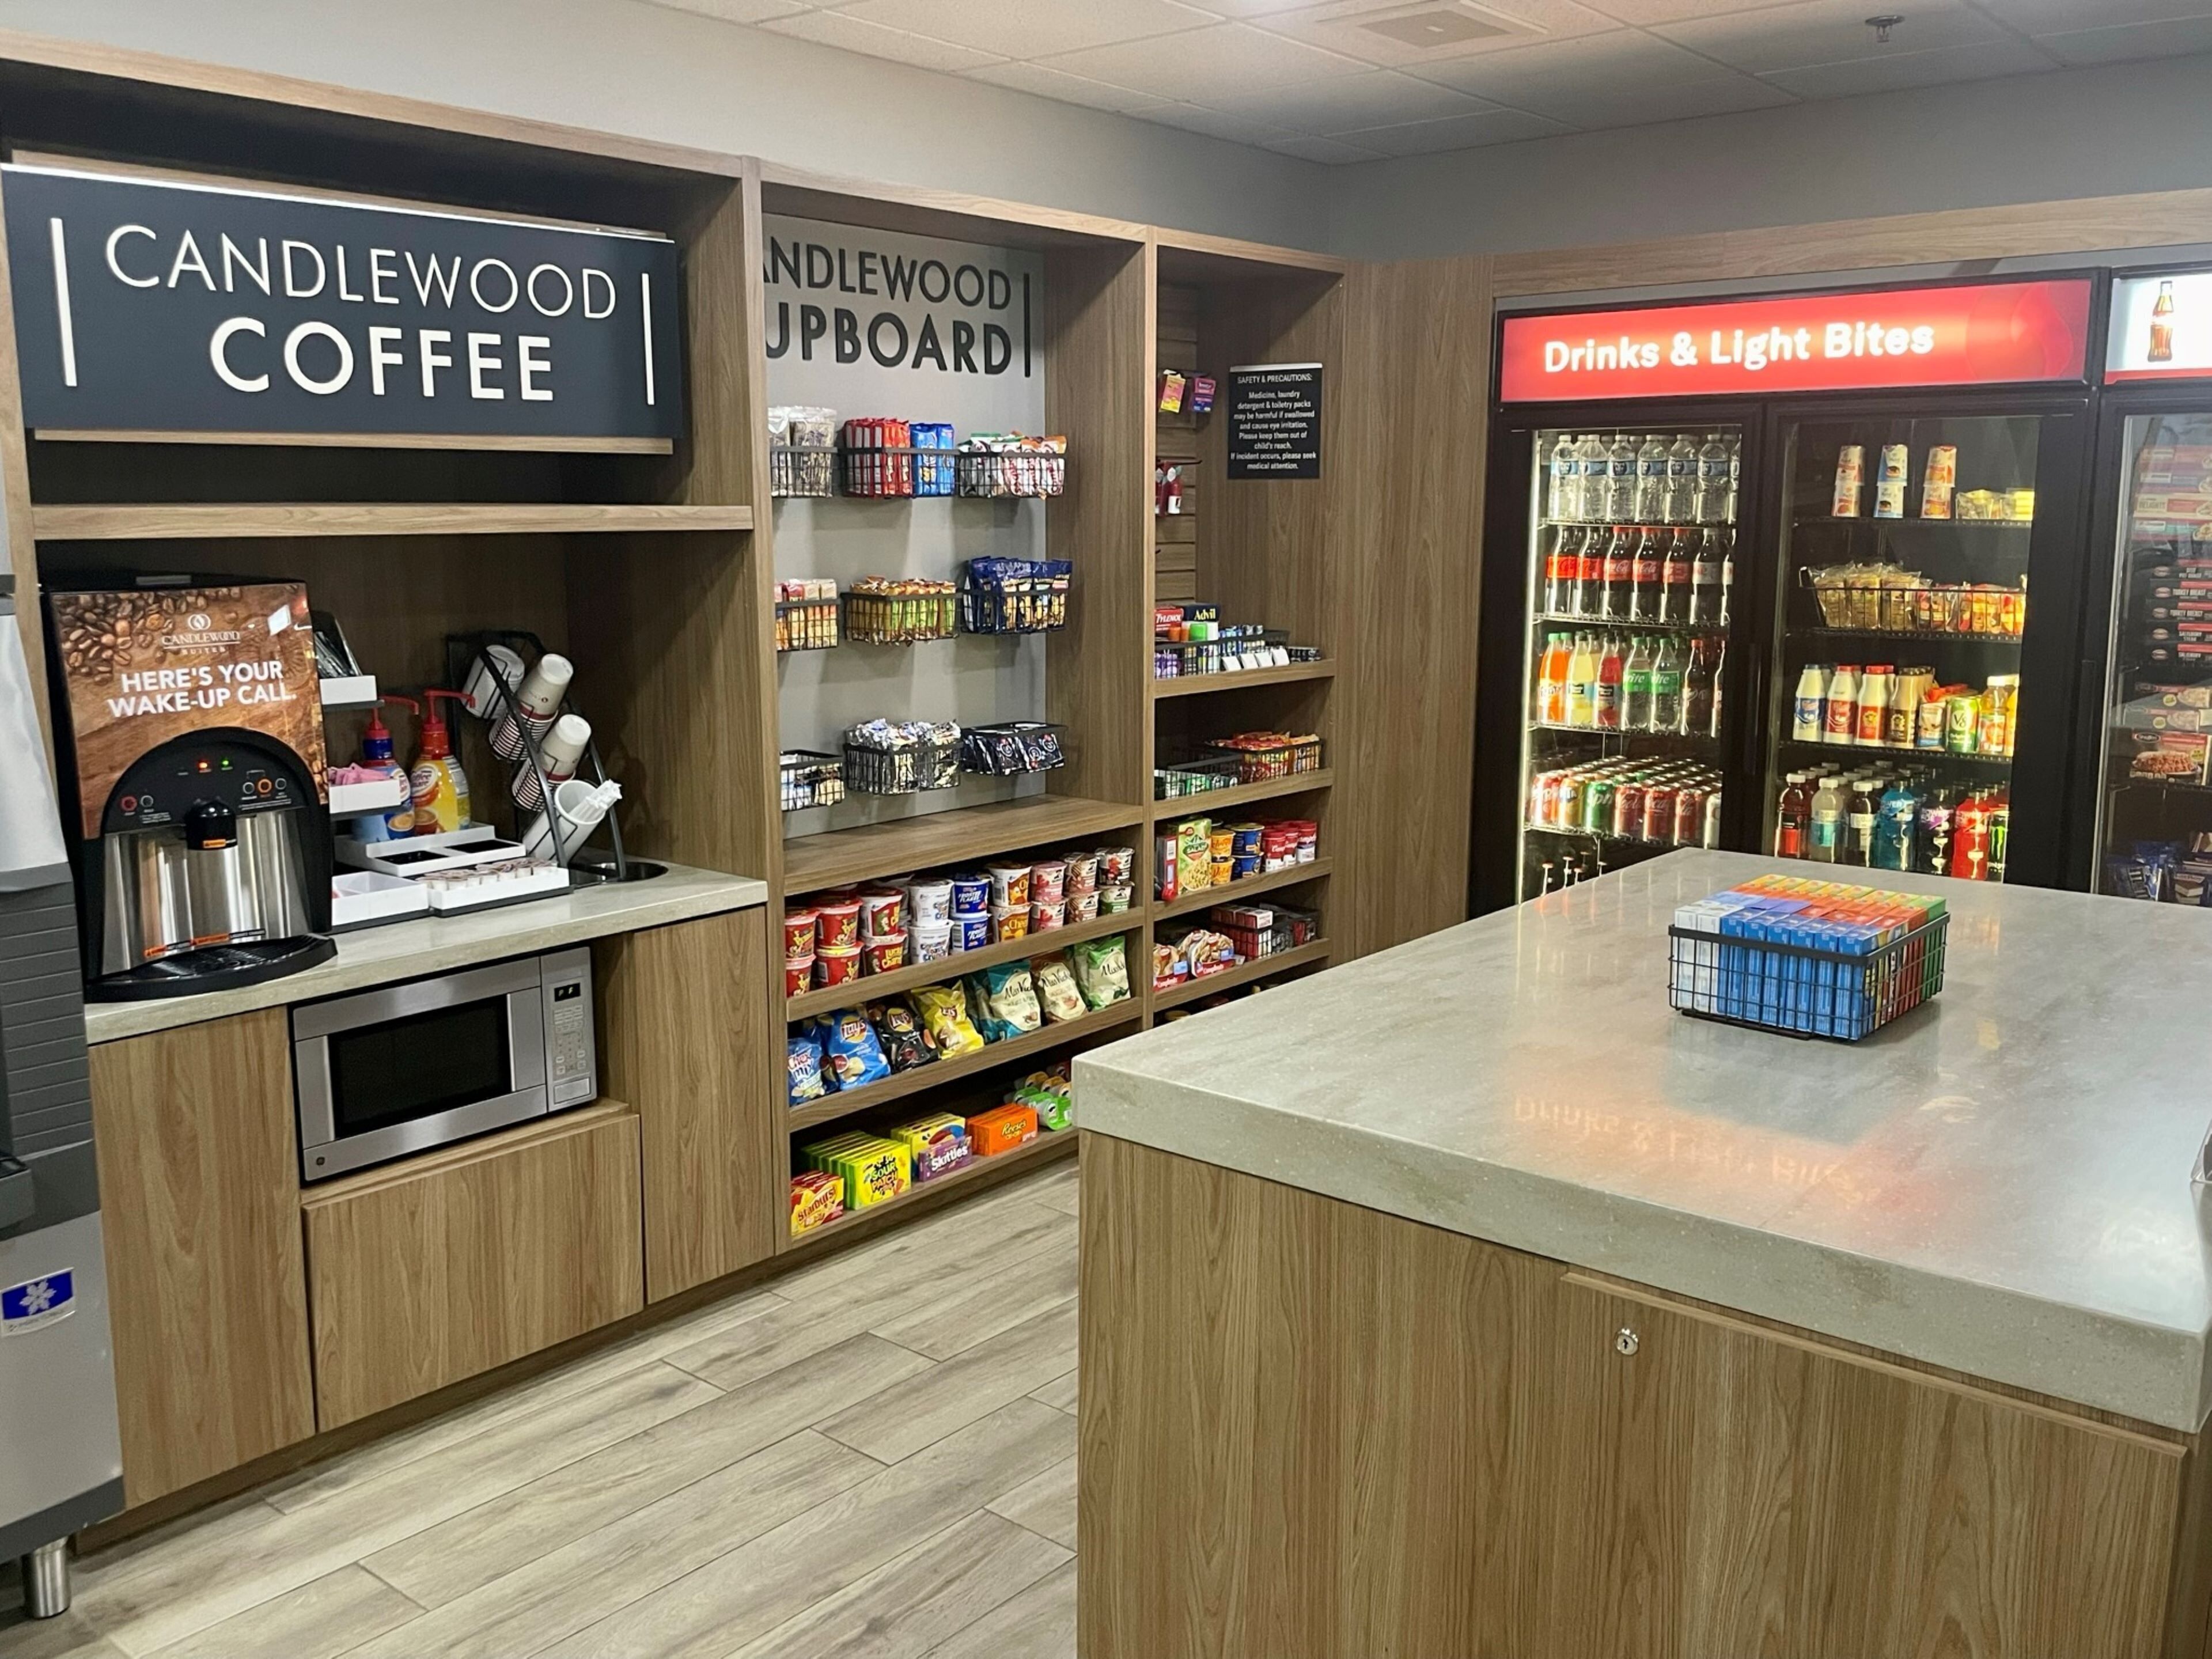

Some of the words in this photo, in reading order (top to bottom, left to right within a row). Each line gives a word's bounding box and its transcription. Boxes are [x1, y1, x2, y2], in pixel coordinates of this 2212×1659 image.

[105, 224, 616, 319] CANDLEWOOD
[763, 235, 1012, 310] NDLEWOOD
[1544, 336, 1660, 373] Drinks
[1670, 331, 1698, 367] &
[1710, 326, 1811, 370] Light
[1824, 321, 1935, 358] Bites
[209, 316, 554, 402] COFFEE
[1237, 376, 1260, 384] SAFETY
[1261, 375, 1266, 383] &
[1267, 373, 1313, 382] PRECAUTIONS:
[1278, 389, 1301, 399] laundry
[1237, 402, 1265, 411] detergent
[1271, 400, 1293, 410] toiletry
[1293, 399, 1312, 410] packs
[1255, 411, 1278, 419] harmful
[1278, 410, 1284, 419] if
[1284, 410, 1315, 419] swallowed
[1269, 423, 1280, 431] eye
[1259, 432, 1273, 441] keep
[1300, 430, 1307, 438] of
[1254, 442, 1273, 450] child's
[1230, 452, 1236, 460] If
[1236, 452, 1260, 460] incident
[1282, 452, 1301, 460] please
[1302, 450, 1316, 459] seek
[1270, 461, 1299, 470] attention.
[1194, 608, 1216, 620] Advil
[161, 631, 241, 645] CANDLEWOOD
[120, 666, 213, 693] HERE'S
[217, 660, 283, 684] YOUR
[107, 687, 231, 718] WAKE-UP
[237, 682, 297, 704] CALL.
[931, 1145, 968, 1172] Skittles
